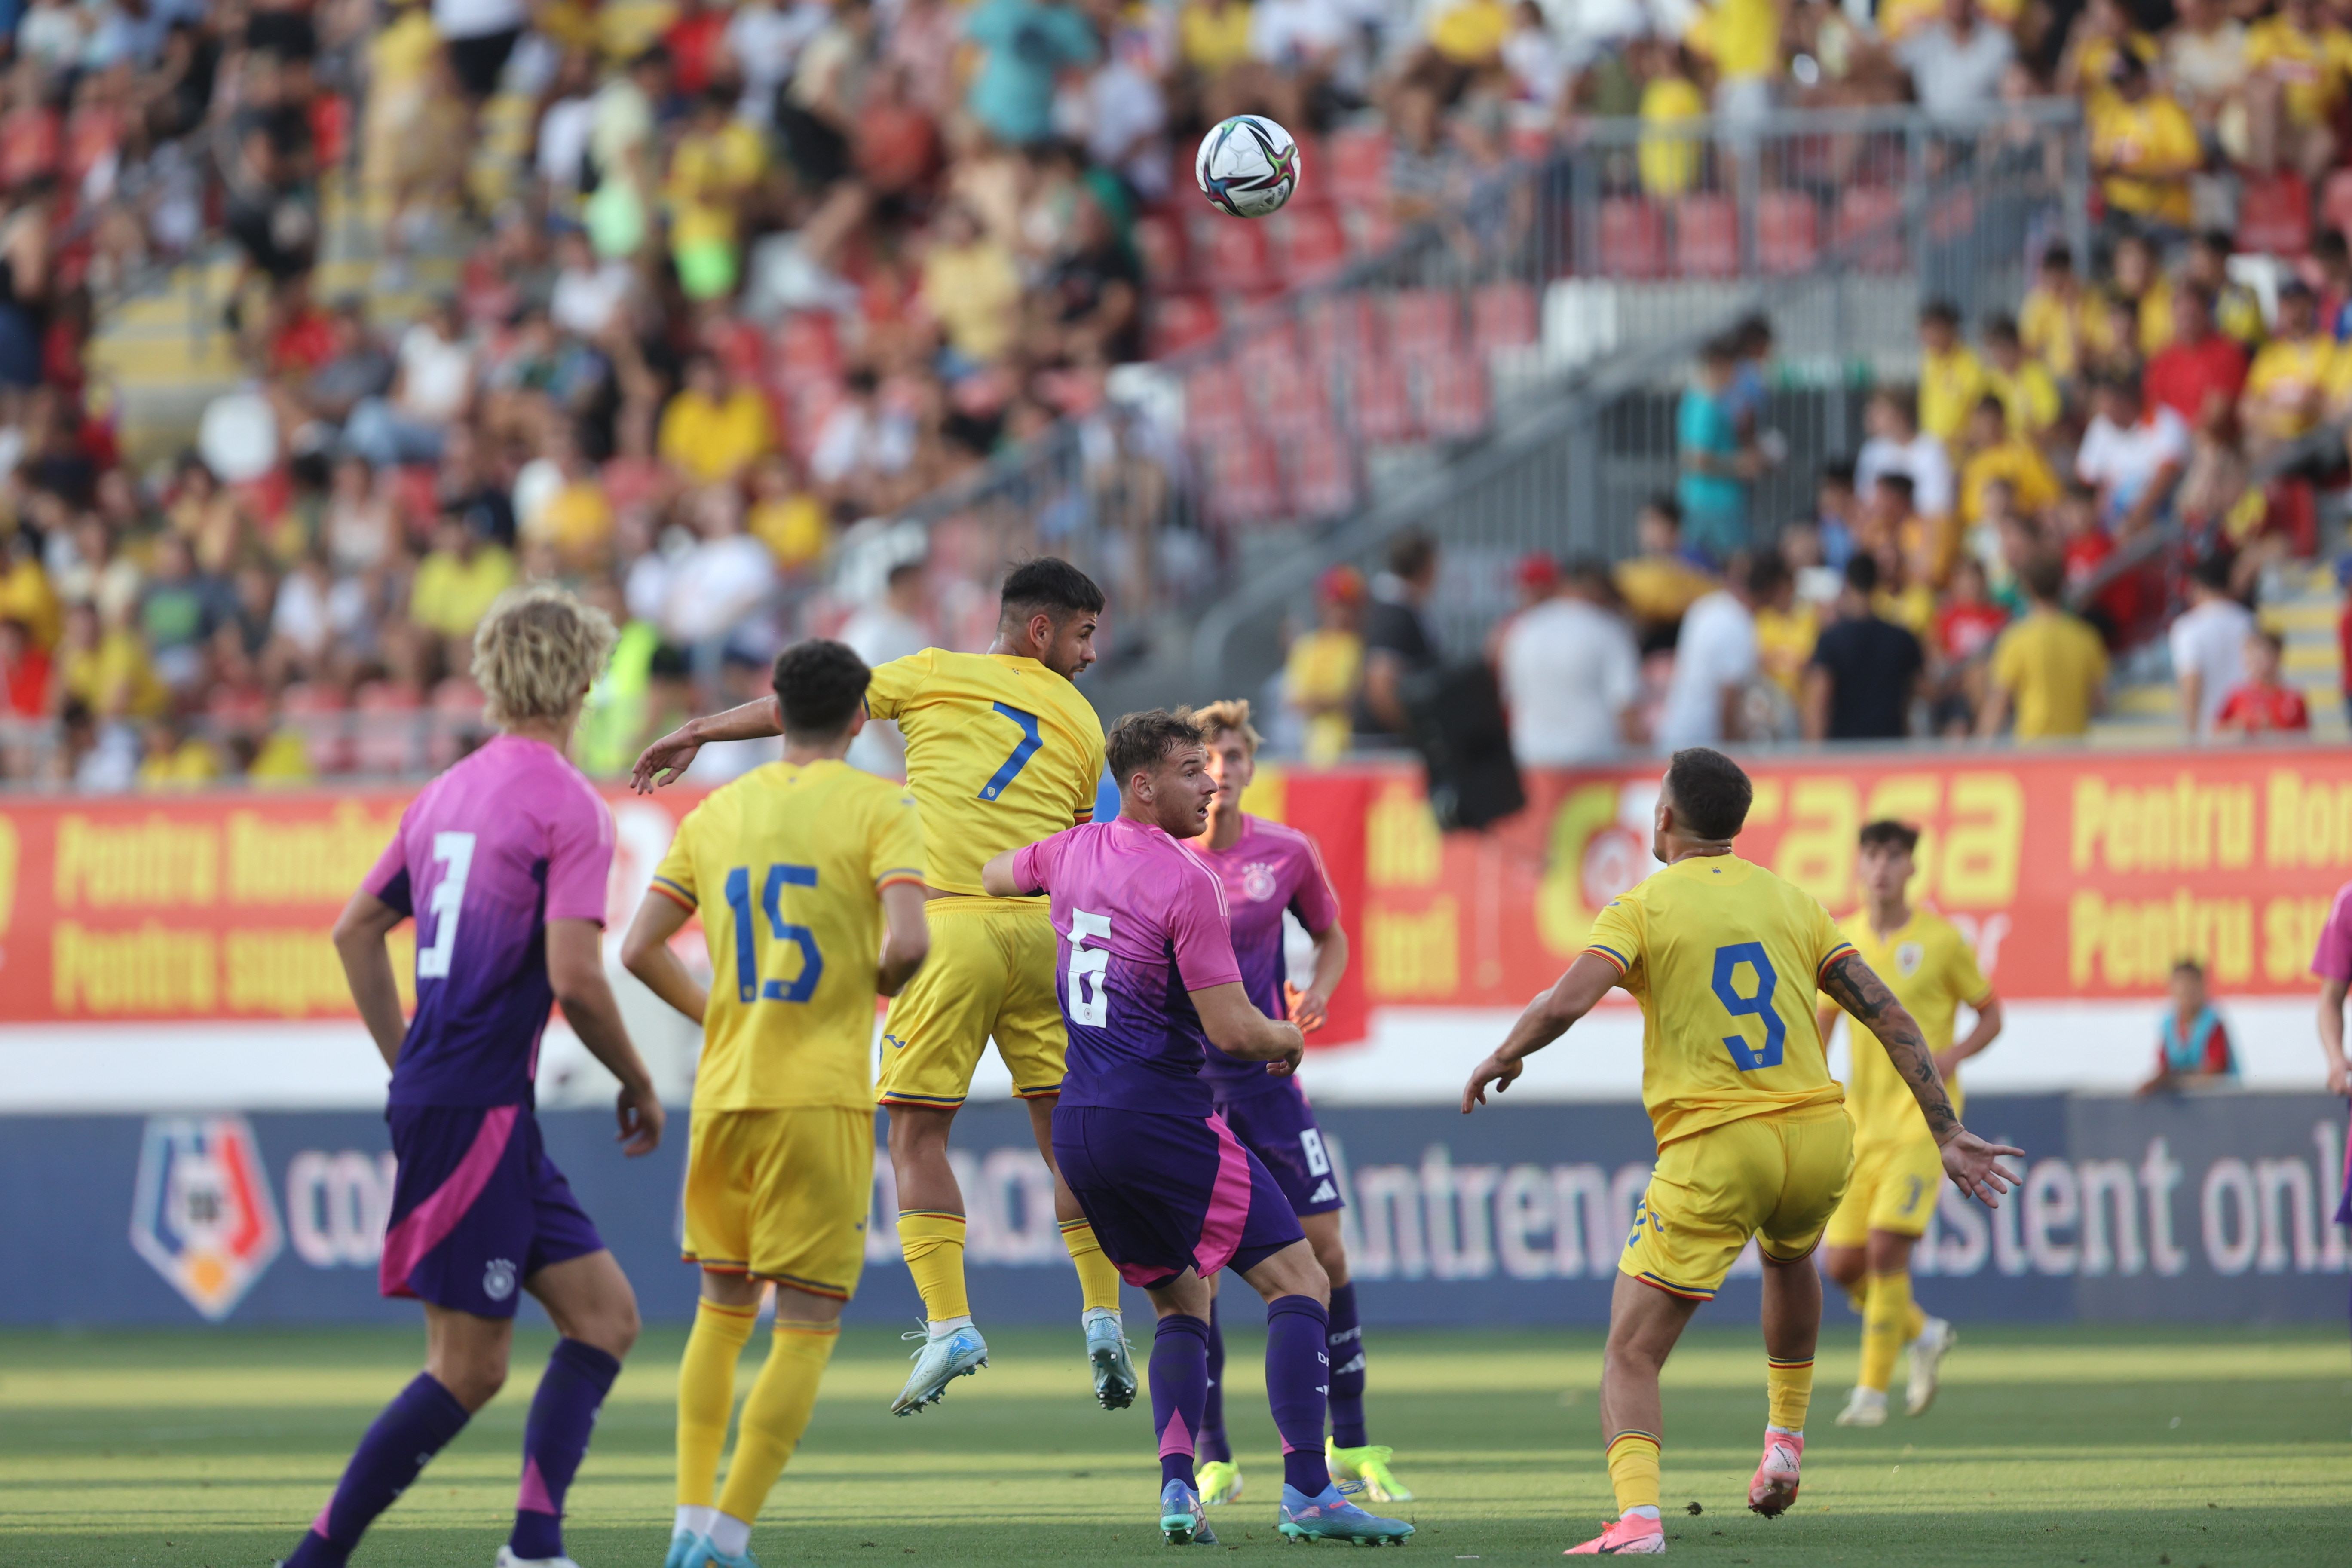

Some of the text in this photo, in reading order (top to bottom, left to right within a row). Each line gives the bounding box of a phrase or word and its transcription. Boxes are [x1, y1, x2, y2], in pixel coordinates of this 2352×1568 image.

[977, 701, 1044, 802] 7
[2072, 769, 2352, 874] Pentru Ro
[417, 830, 477, 979] 3
[725, 864, 824, 1003] 15
[2070, 888, 2253, 988] Pentru
[1067, 907, 1112, 1028] 6
[1712, 941, 1786, 1072] 9
[1299, 1127, 1331, 1178] 8
